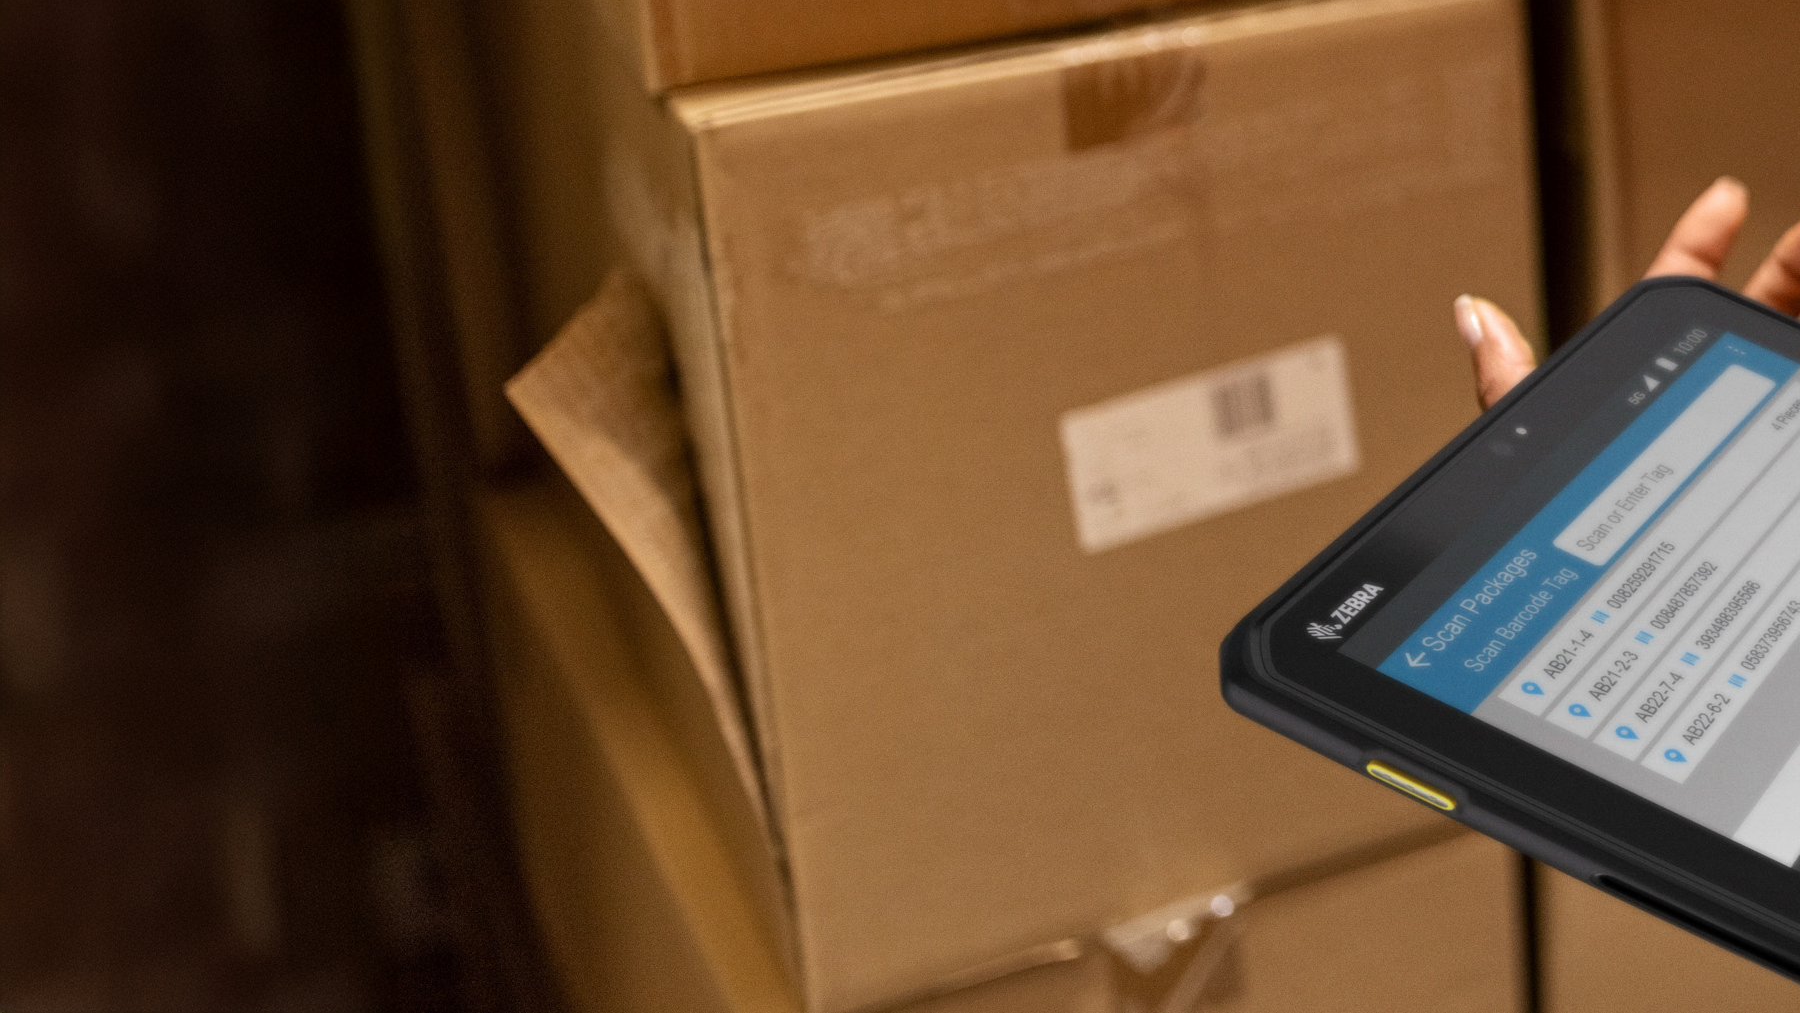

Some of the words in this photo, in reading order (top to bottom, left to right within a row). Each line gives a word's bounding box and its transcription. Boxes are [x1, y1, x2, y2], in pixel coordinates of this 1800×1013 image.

[1674, 328, 1707, 356] 10:00
[1628, 391, 1646, 405] 5G
[1770, 422, 1783, 432] 4
[1640, 463, 1674, 488] Tag
[1615, 485, 1650, 512] Enter
[1607, 509, 1625, 525] or
[1576, 520, 1613, 551] Scan
[1330, 583, 1384, 625] ZEBRA
[1422, 612, 1472, 651] Scan
[1460, 549, 1537, 615] Packages
[1543, 629, 1594, 680] AB21-1-4
[1606, 540, 1675, 610] 008259291715
[1464, 638, 1504, 672] Scan
[1495, 587, 1553, 640] Barcode
[1542, 566, 1579, 592] Tag
[1588, 650, 1639, 702] AB21-2-3
[1635, 671, 1684, 723] AB22-7-4
[1682, 692, 1731, 746] AB22-6-2
